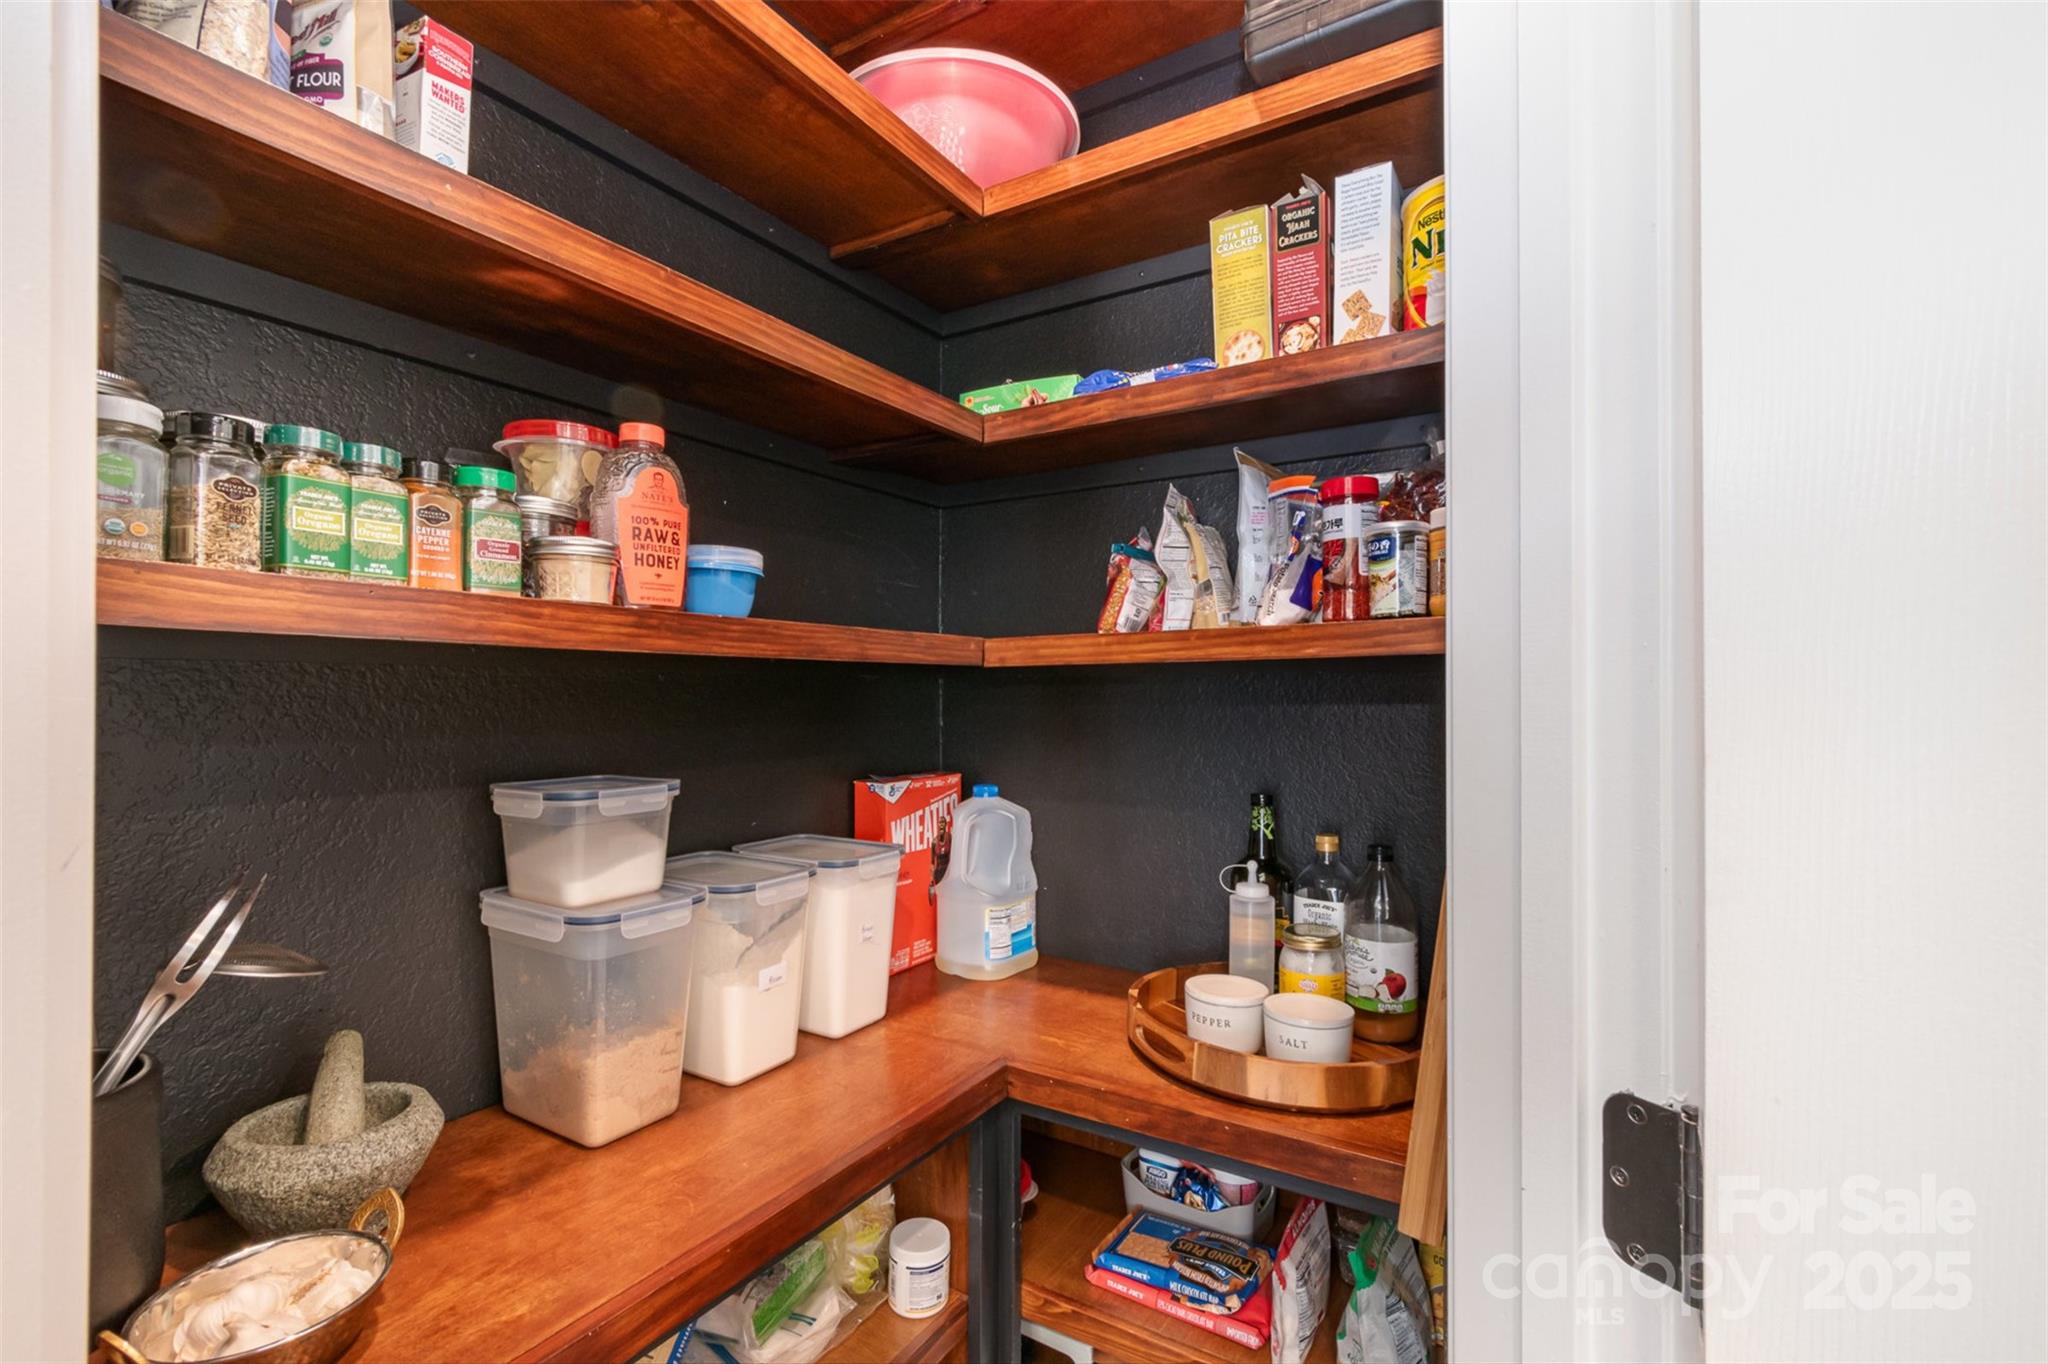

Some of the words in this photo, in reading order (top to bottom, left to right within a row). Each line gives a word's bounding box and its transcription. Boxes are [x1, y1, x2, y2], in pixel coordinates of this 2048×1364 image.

[296, 71, 342, 88] FLOUR
[431, 80, 465, 106] MAKERS
[431, 88, 465, 114] WANTED
[1281, 206, 1316, 222] ORGANIC
[1218, 231, 1238, 244] PITA
[1240, 225, 1259, 237] BITE
[1278, 229, 1319, 248] CRACKERS
[1216, 233, 1263, 254] CRACKERS
[218, 482, 252, 492] PRIVATE
[222, 513, 247, 526] SEED
[419, 509, 447, 517] PRIVATE
[631, 515, 659, 527] 100%
[663, 519, 682, 531] PURE
[415, 525, 452, 538] CAYENNE
[631, 526, 668, 544] RAW
[671, 531, 681, 547] &
[416, 535, 450, 546] PEPPER
[479, 550, 518, 560] Cinnamon
[633, 542, 682, 556] UNFILTERED
[634, 552, 681, 571] HONEY
[1303, 902, 1320, 910] TRADER
[1307, 909, 1332, 921] Organic
[1191, 1011, 1232, 1029] PEPPER
[1279, 1034, 1309, 1050] SALT
[1176, 1238, 1206, 1257] PLUS
[1208, 1248, 1252, 1275] POUND
[1111, 1264, 1131, 1276] TRADER
[1107, 1279, 1127, 1293] TRADER
[1181, 1284, 1208, 1301] CHOCOLATE
[1208, 1292, 1219, 1303] BAR
